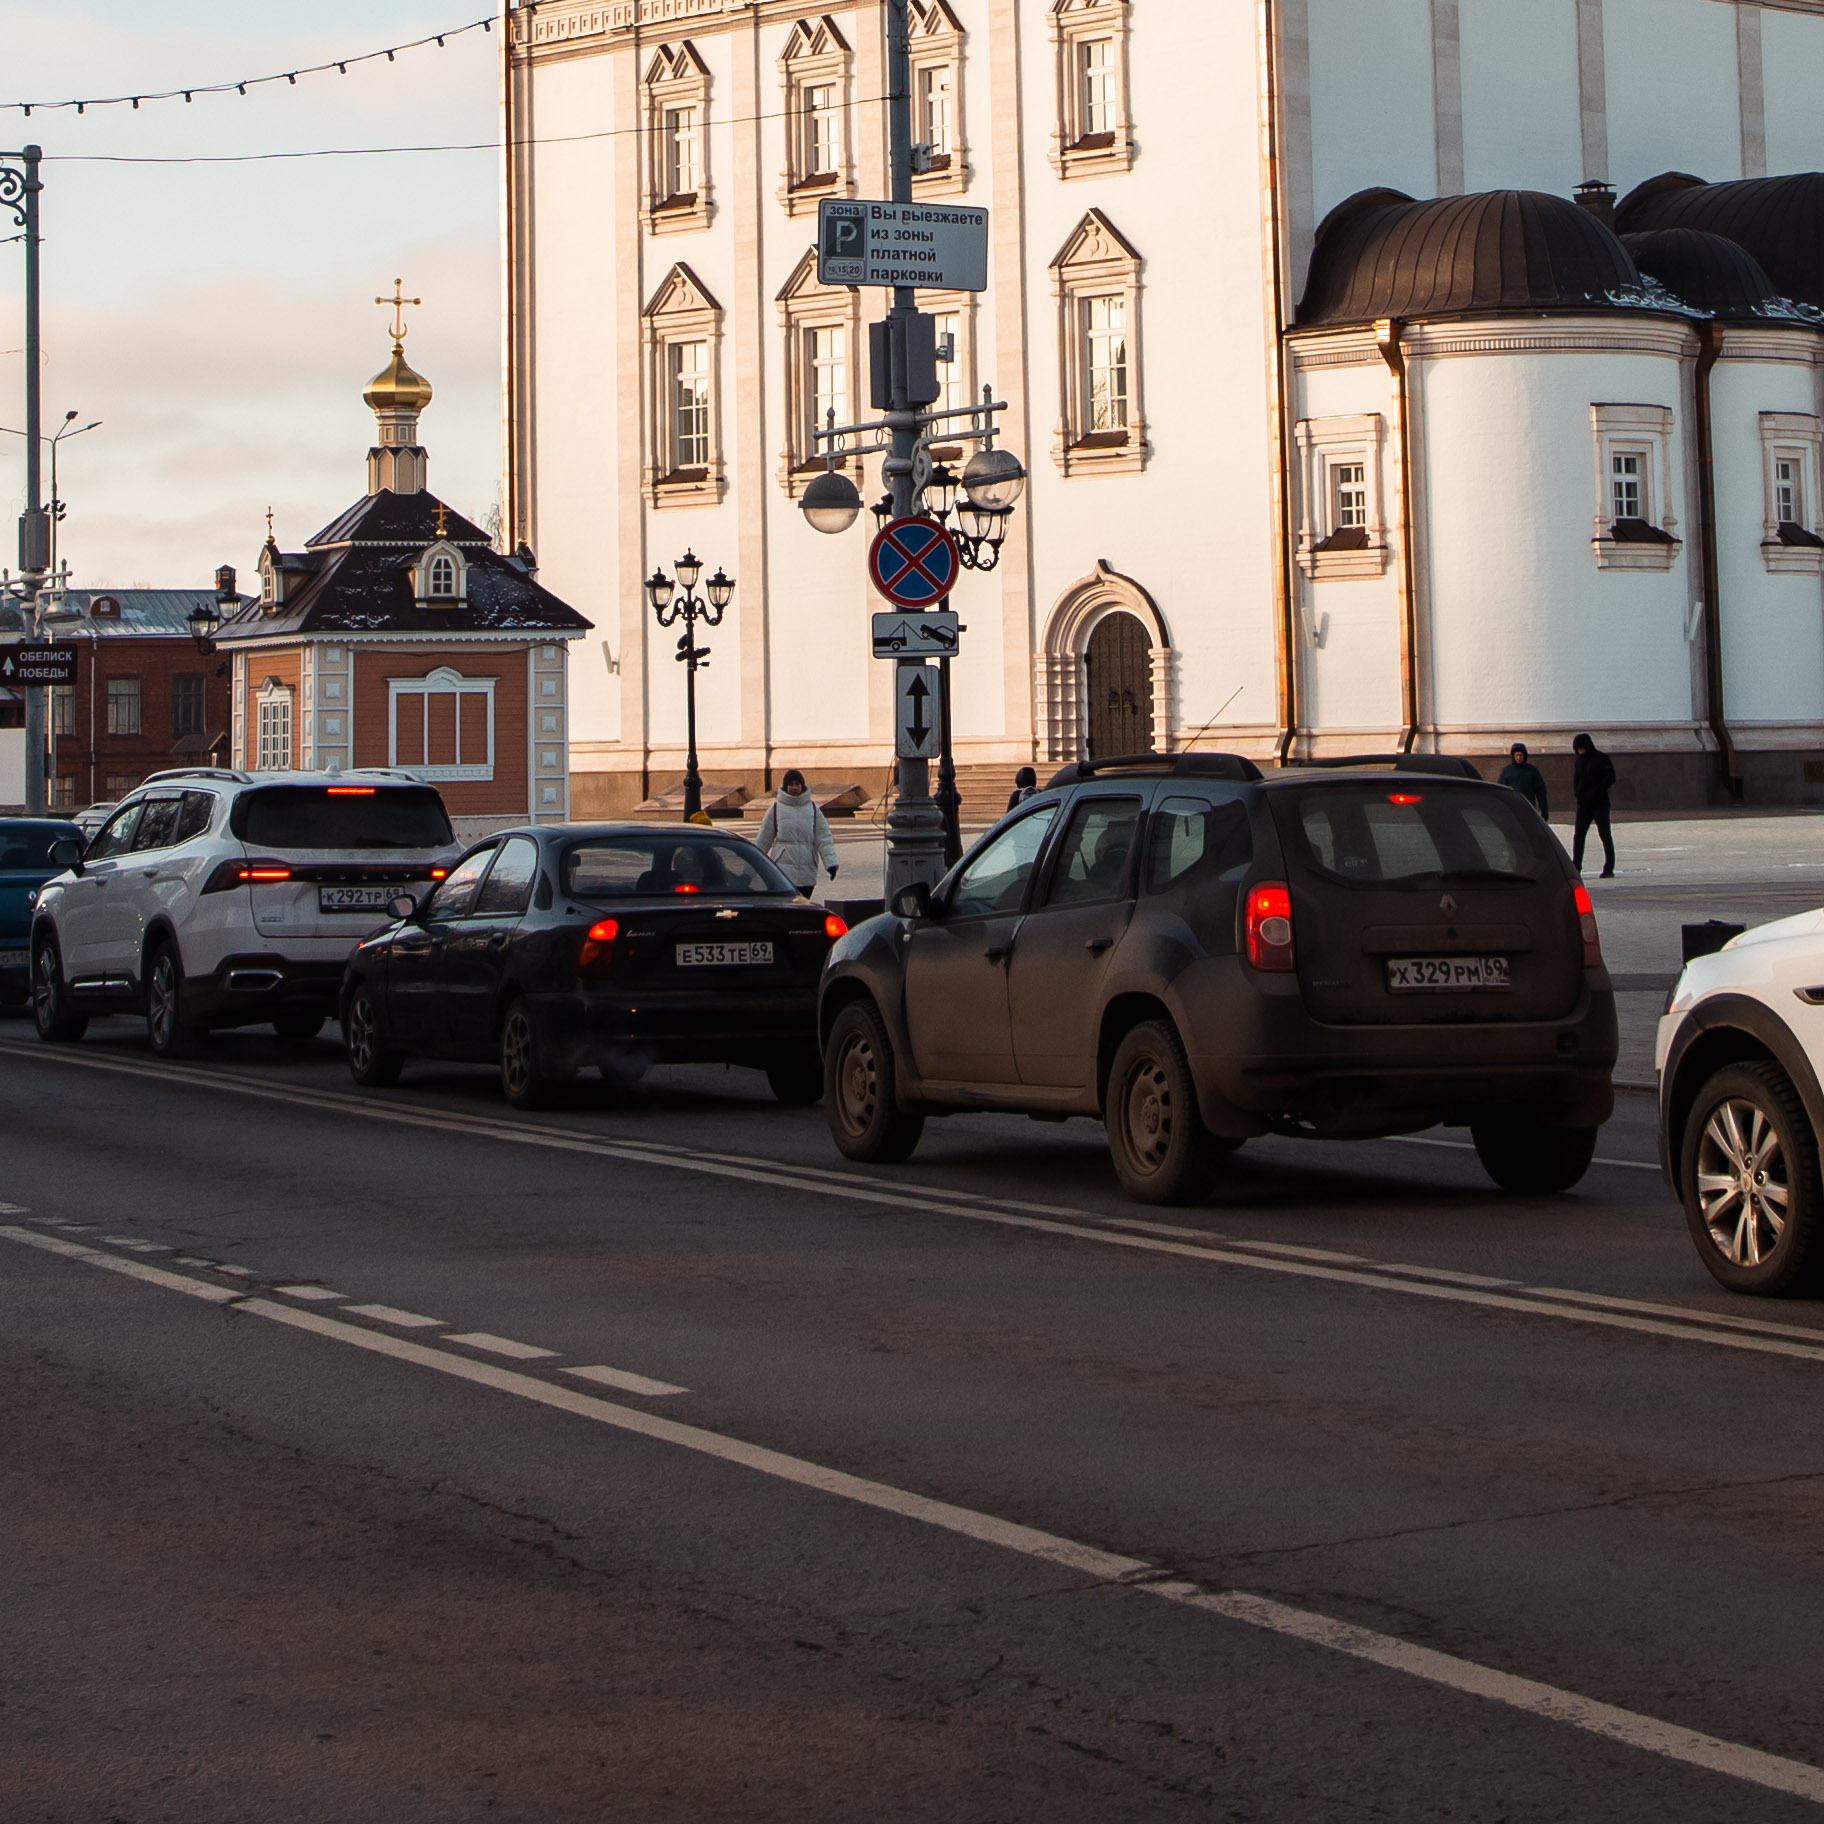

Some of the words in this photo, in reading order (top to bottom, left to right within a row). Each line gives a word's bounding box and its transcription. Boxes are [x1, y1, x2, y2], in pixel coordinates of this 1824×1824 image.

[829, 205, 860, 216] зона
[871, 206, 896, 220] Вы
[901, 210, 983, 226] выезжаете
[871, 229, 889, 240] из
[894, 229, 933, 242] зоны
[870, 248, 936, 263] платной
[837, 265, 847, 274] 15
[849, 265, 860, 274] 20
[870, 268, 943, 284] парковки
[19, 651, 72, 662] ОБЕЛИСК
[19, 667, 69, 679] ПОБЕДЫ
[326, 889, 383, 904] К292ТР
[682, 945, 748, 964] Е533ТЕ
[752, 943, 768, 957] 69
[1397, 961, 1481, 986] Х329РМ
[1484, 959, 1504, 977] 69
